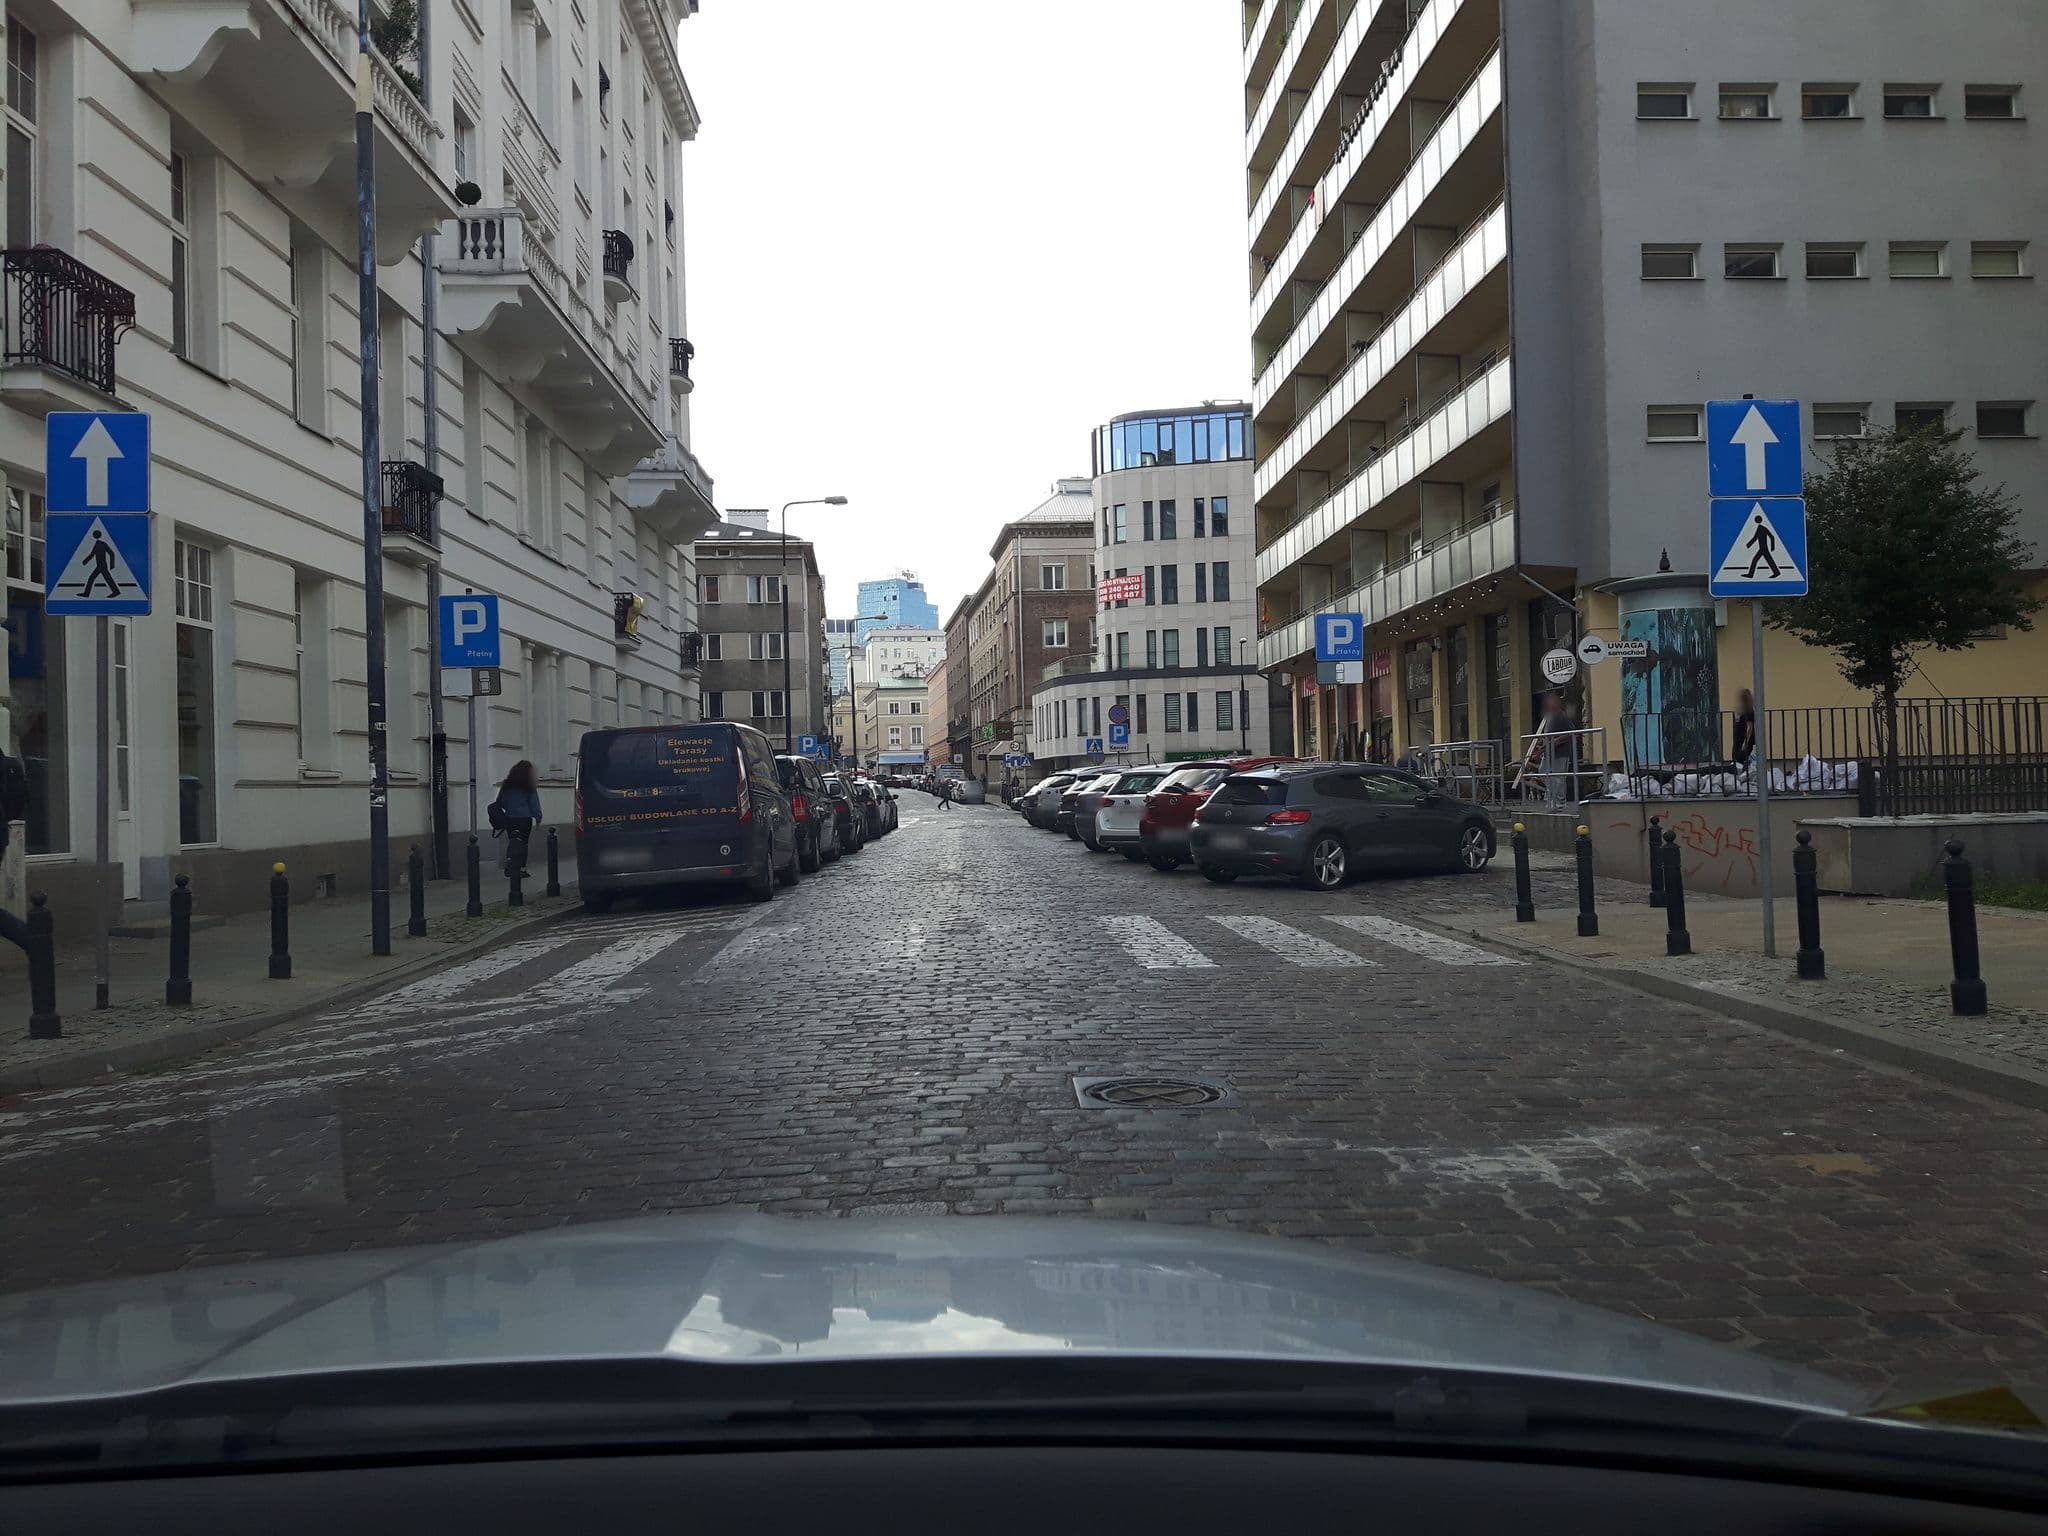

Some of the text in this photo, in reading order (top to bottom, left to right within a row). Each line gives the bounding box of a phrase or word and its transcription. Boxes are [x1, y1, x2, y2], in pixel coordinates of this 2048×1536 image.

[453, 602, 486, 646] P
[1327, 619, 1353, 655] P
[1547, 657, 1572, 672] LABOUR
[1114, 726, 1124, 741] P
[667, 738, 713, 746] Elewacje
[674, 747, 707, 755] Tarasy
[630, 808, 699, 820] BUDOWLANE
[701, 807, 718, 815] OD
[720, 806, 738, 814] A-Z
